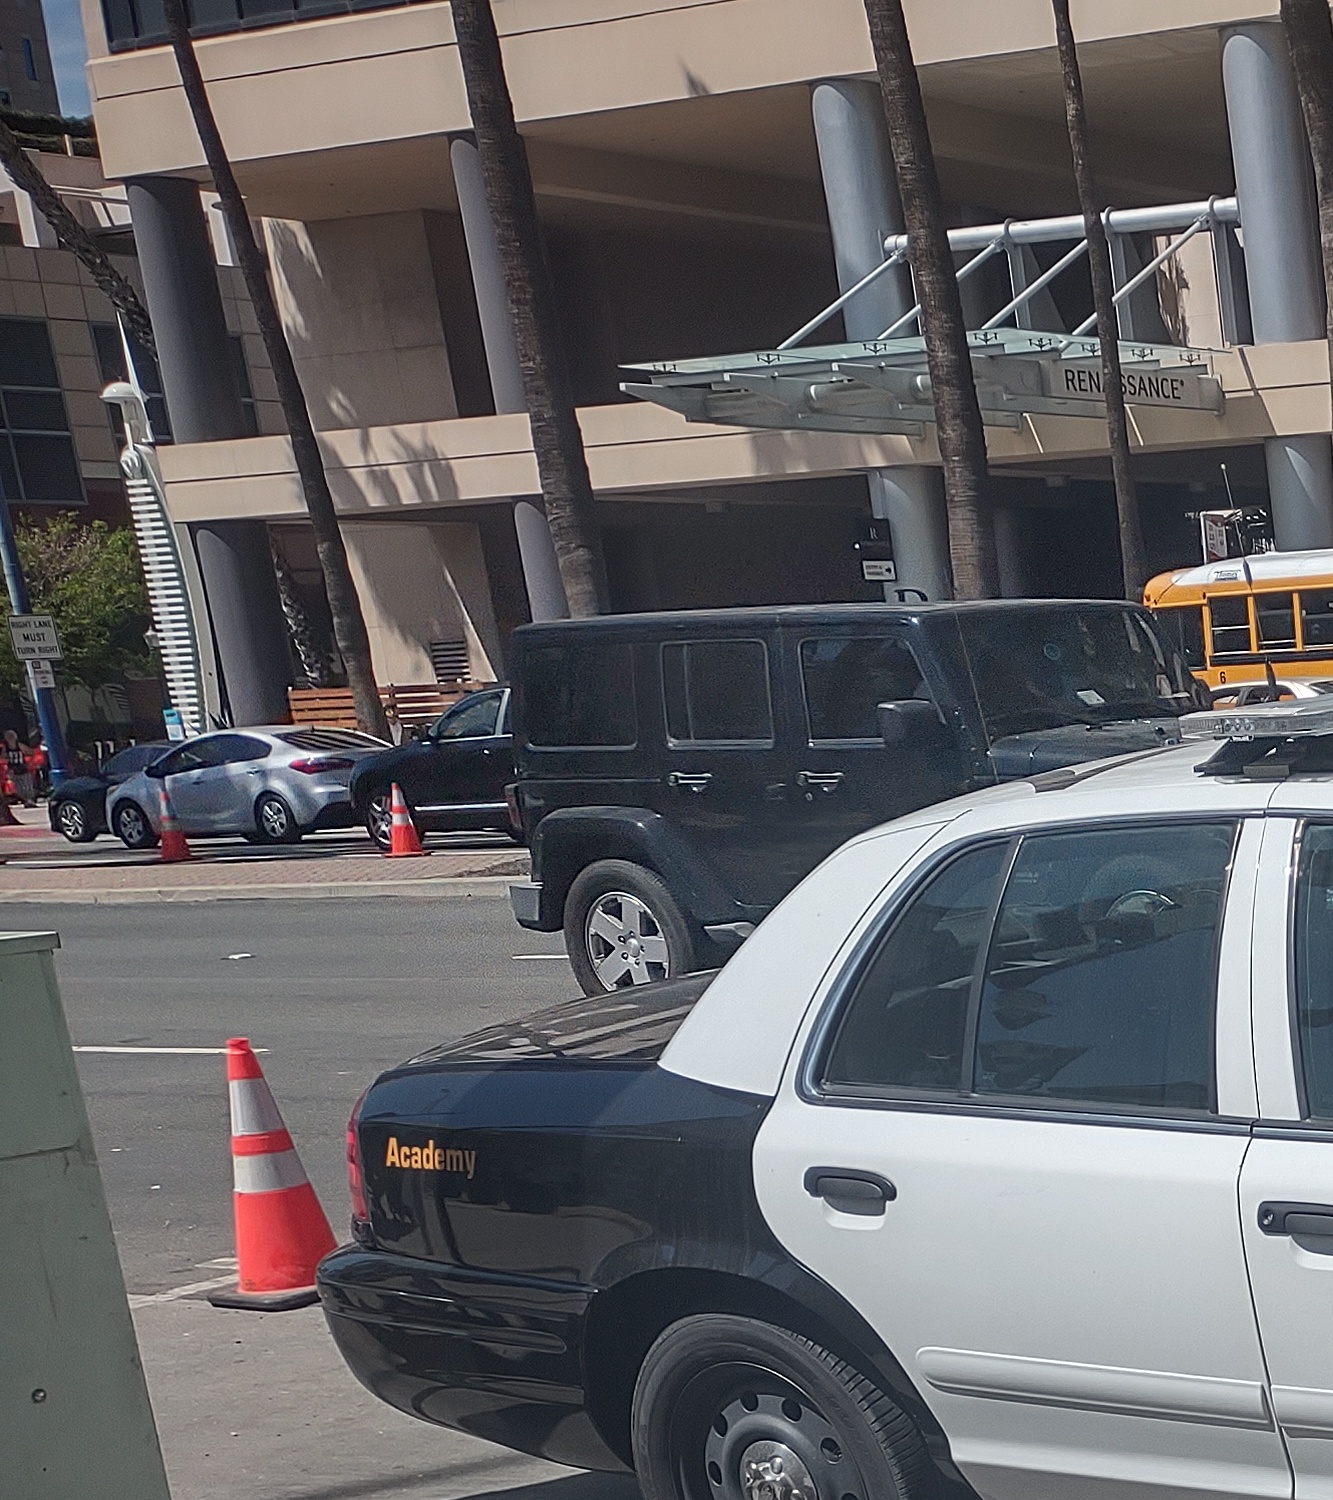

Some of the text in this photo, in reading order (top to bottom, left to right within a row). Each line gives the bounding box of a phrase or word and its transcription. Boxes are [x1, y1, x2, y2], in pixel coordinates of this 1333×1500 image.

[1064, 368, 1184, 400] RENSSANCE
[22, 632, 46, 642] MUST
[1219, 671, 1227, 684] 6
[385, 1137, 476, 1179] Academy
